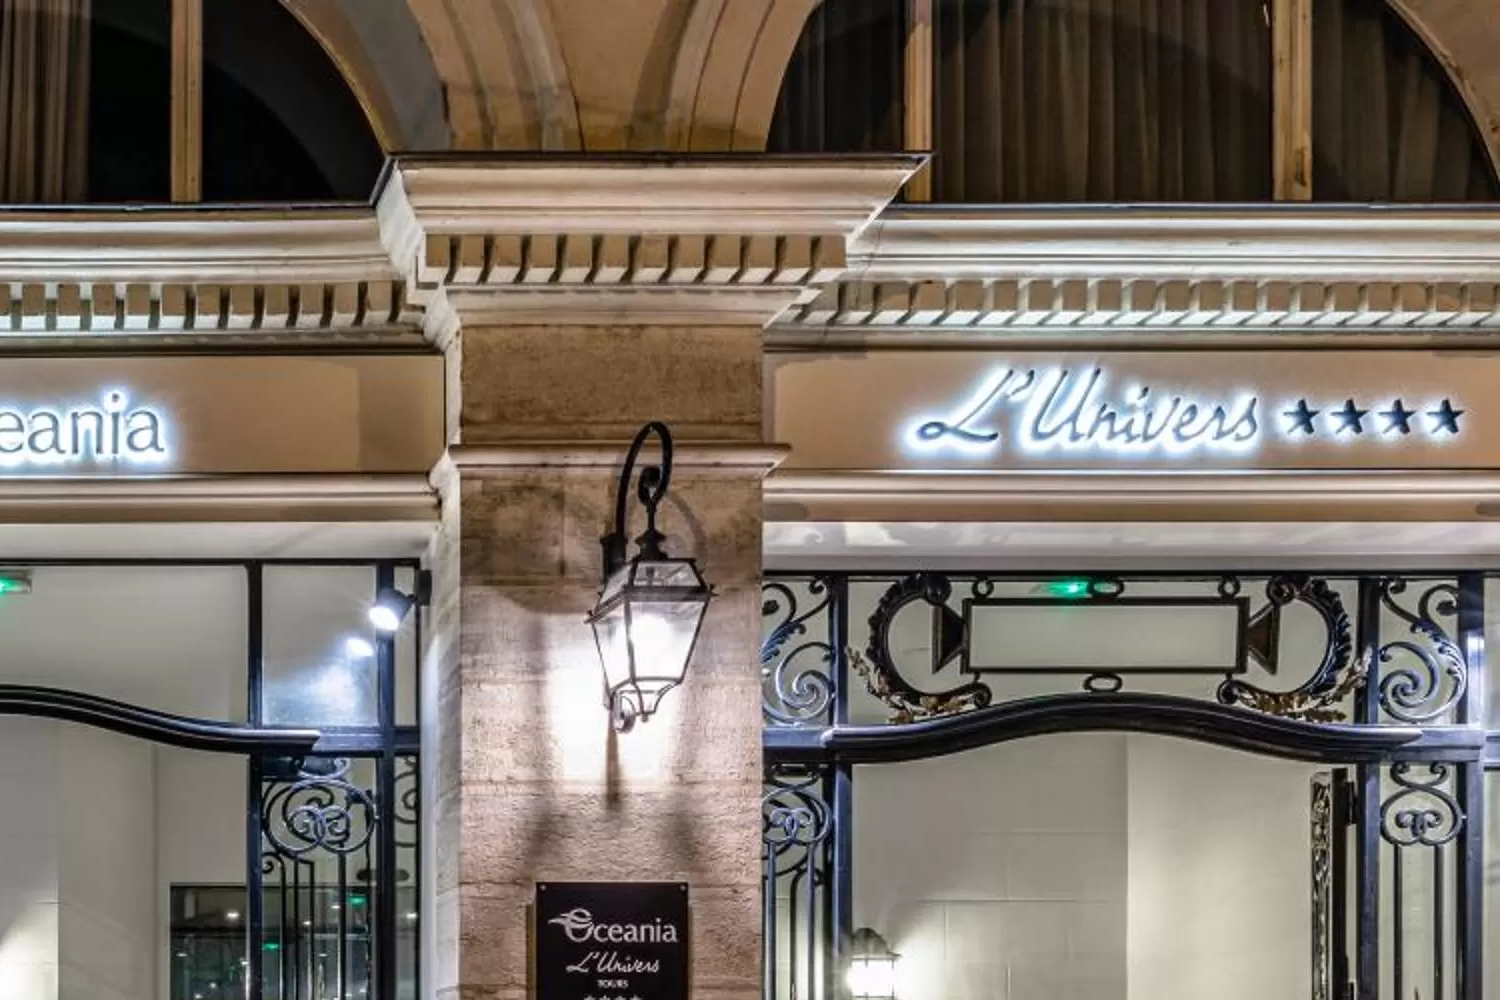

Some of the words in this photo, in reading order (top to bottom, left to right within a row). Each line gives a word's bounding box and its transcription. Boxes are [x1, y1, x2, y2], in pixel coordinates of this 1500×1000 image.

[916, 366, 1260, 444] L'Univers
[547, 907, 678, 943] Oceania
[565, 951, 661, 973] L'Univers
